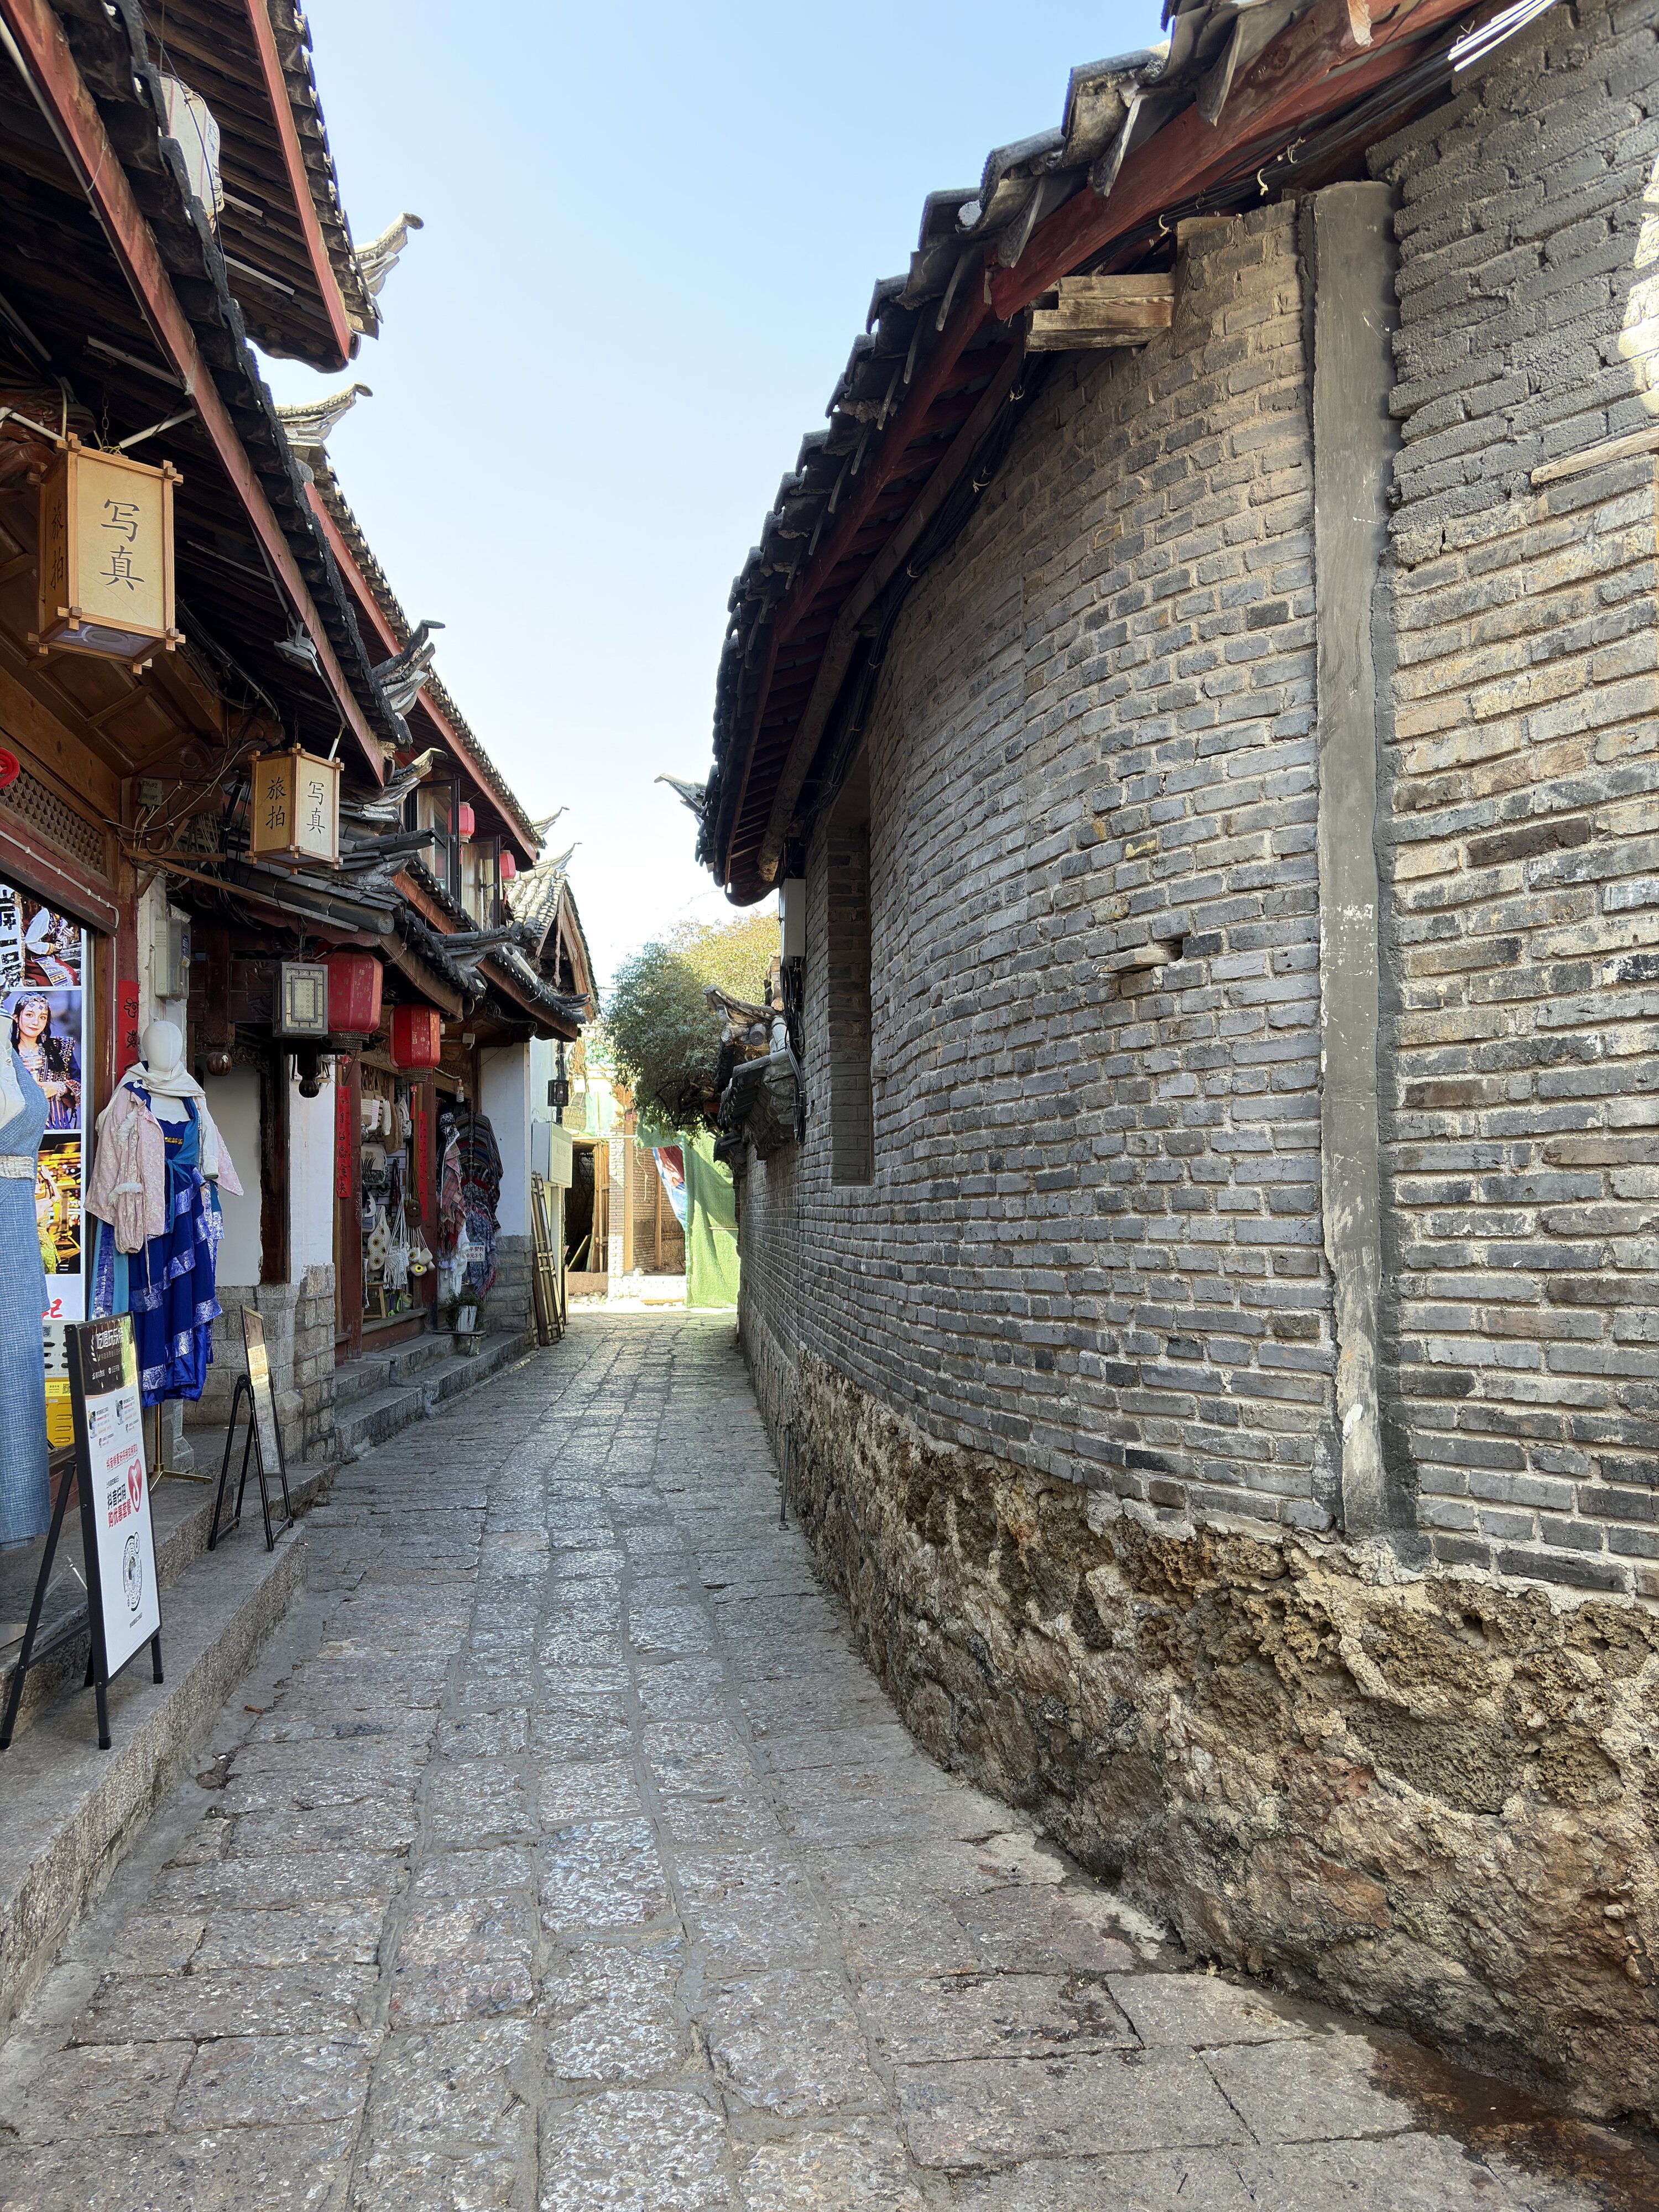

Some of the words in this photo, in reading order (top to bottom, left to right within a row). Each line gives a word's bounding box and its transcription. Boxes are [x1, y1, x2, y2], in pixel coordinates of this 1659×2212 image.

[50, 499, 64, 591] 旅拍
[100, 499, 145, 591] 写真
[265, 776, 286, 830] 旅拍
[306, 780, 325, 834] 写真
[107, 1483, 127, 1510] 抖音扫码
[108, 1498, 132, 1528] 购优惠套餐
